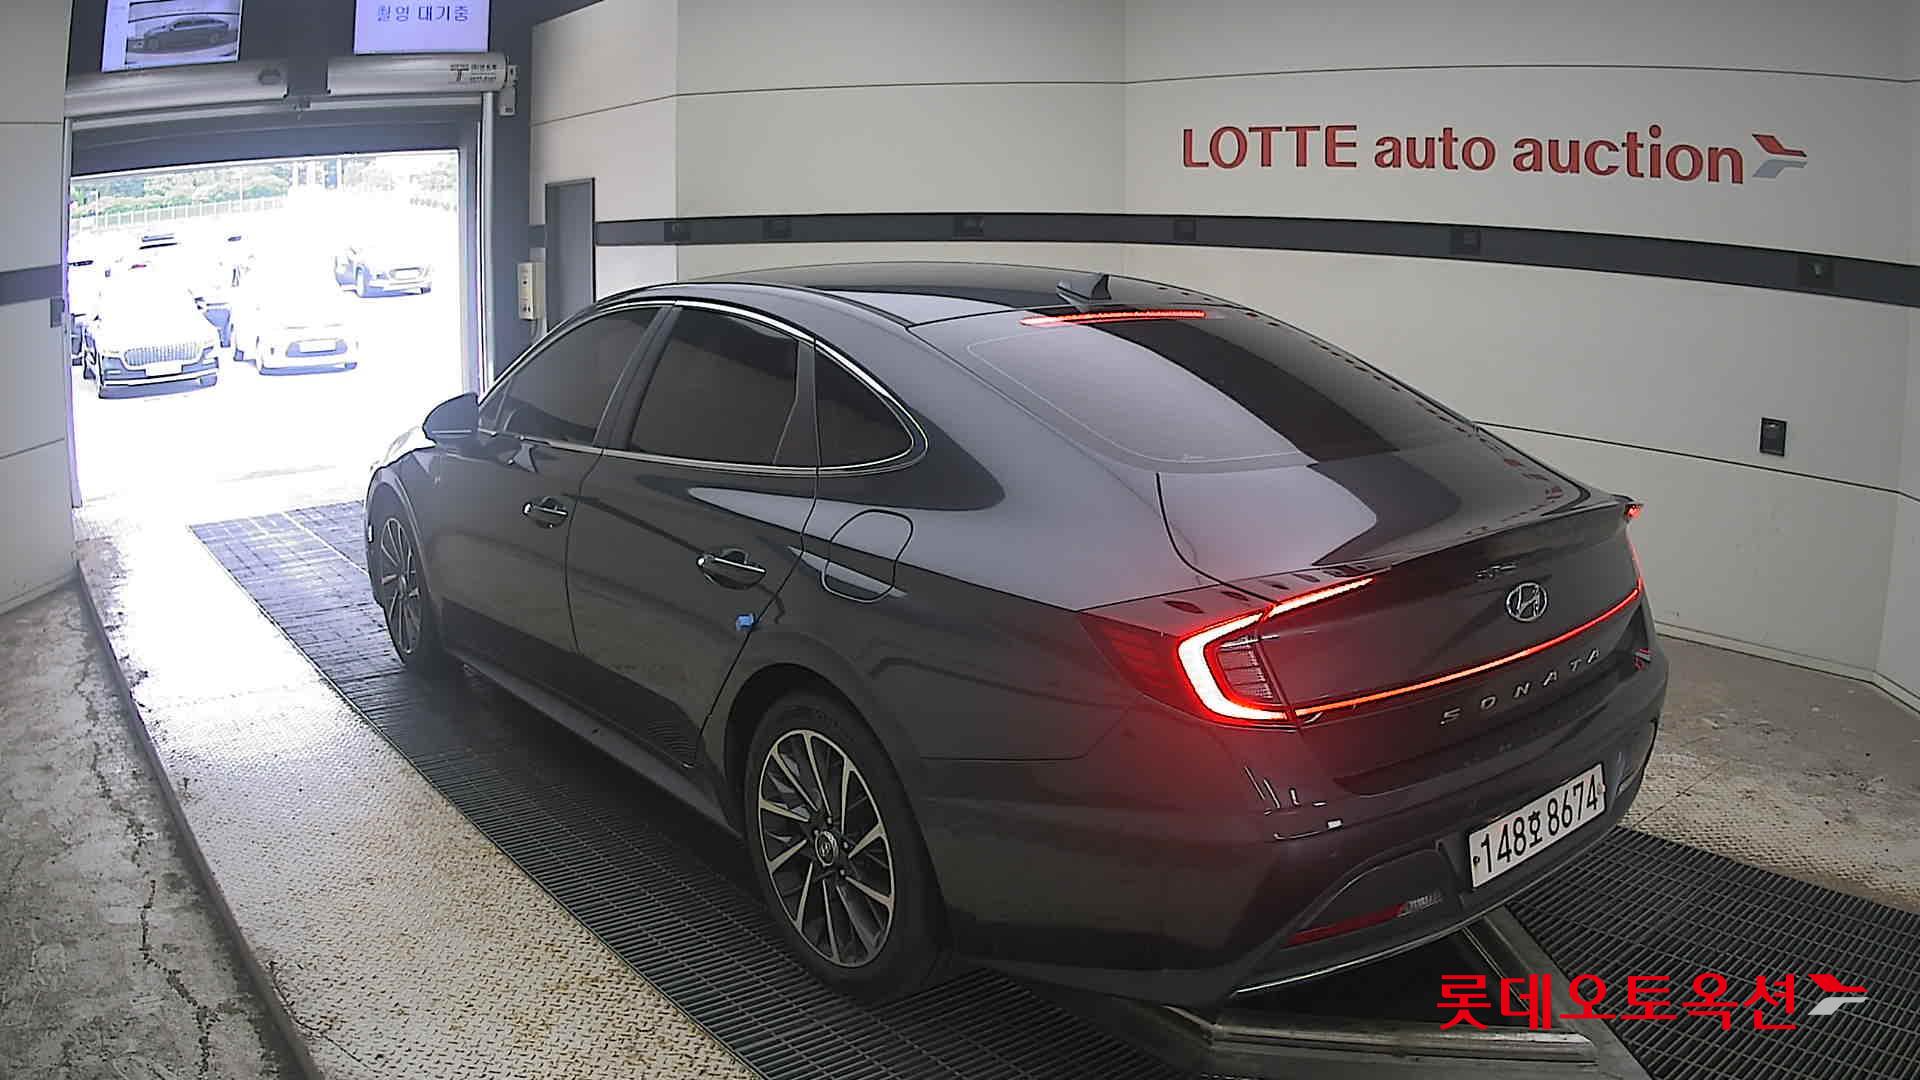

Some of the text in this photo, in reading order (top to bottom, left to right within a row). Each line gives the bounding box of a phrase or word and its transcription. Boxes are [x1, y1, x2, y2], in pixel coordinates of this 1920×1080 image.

[418, 5, 469, 22] 대기중
[1182, 124, 1745, 185] LOTTE auto auction
[1440, 647, 1602, 726] SONATA
